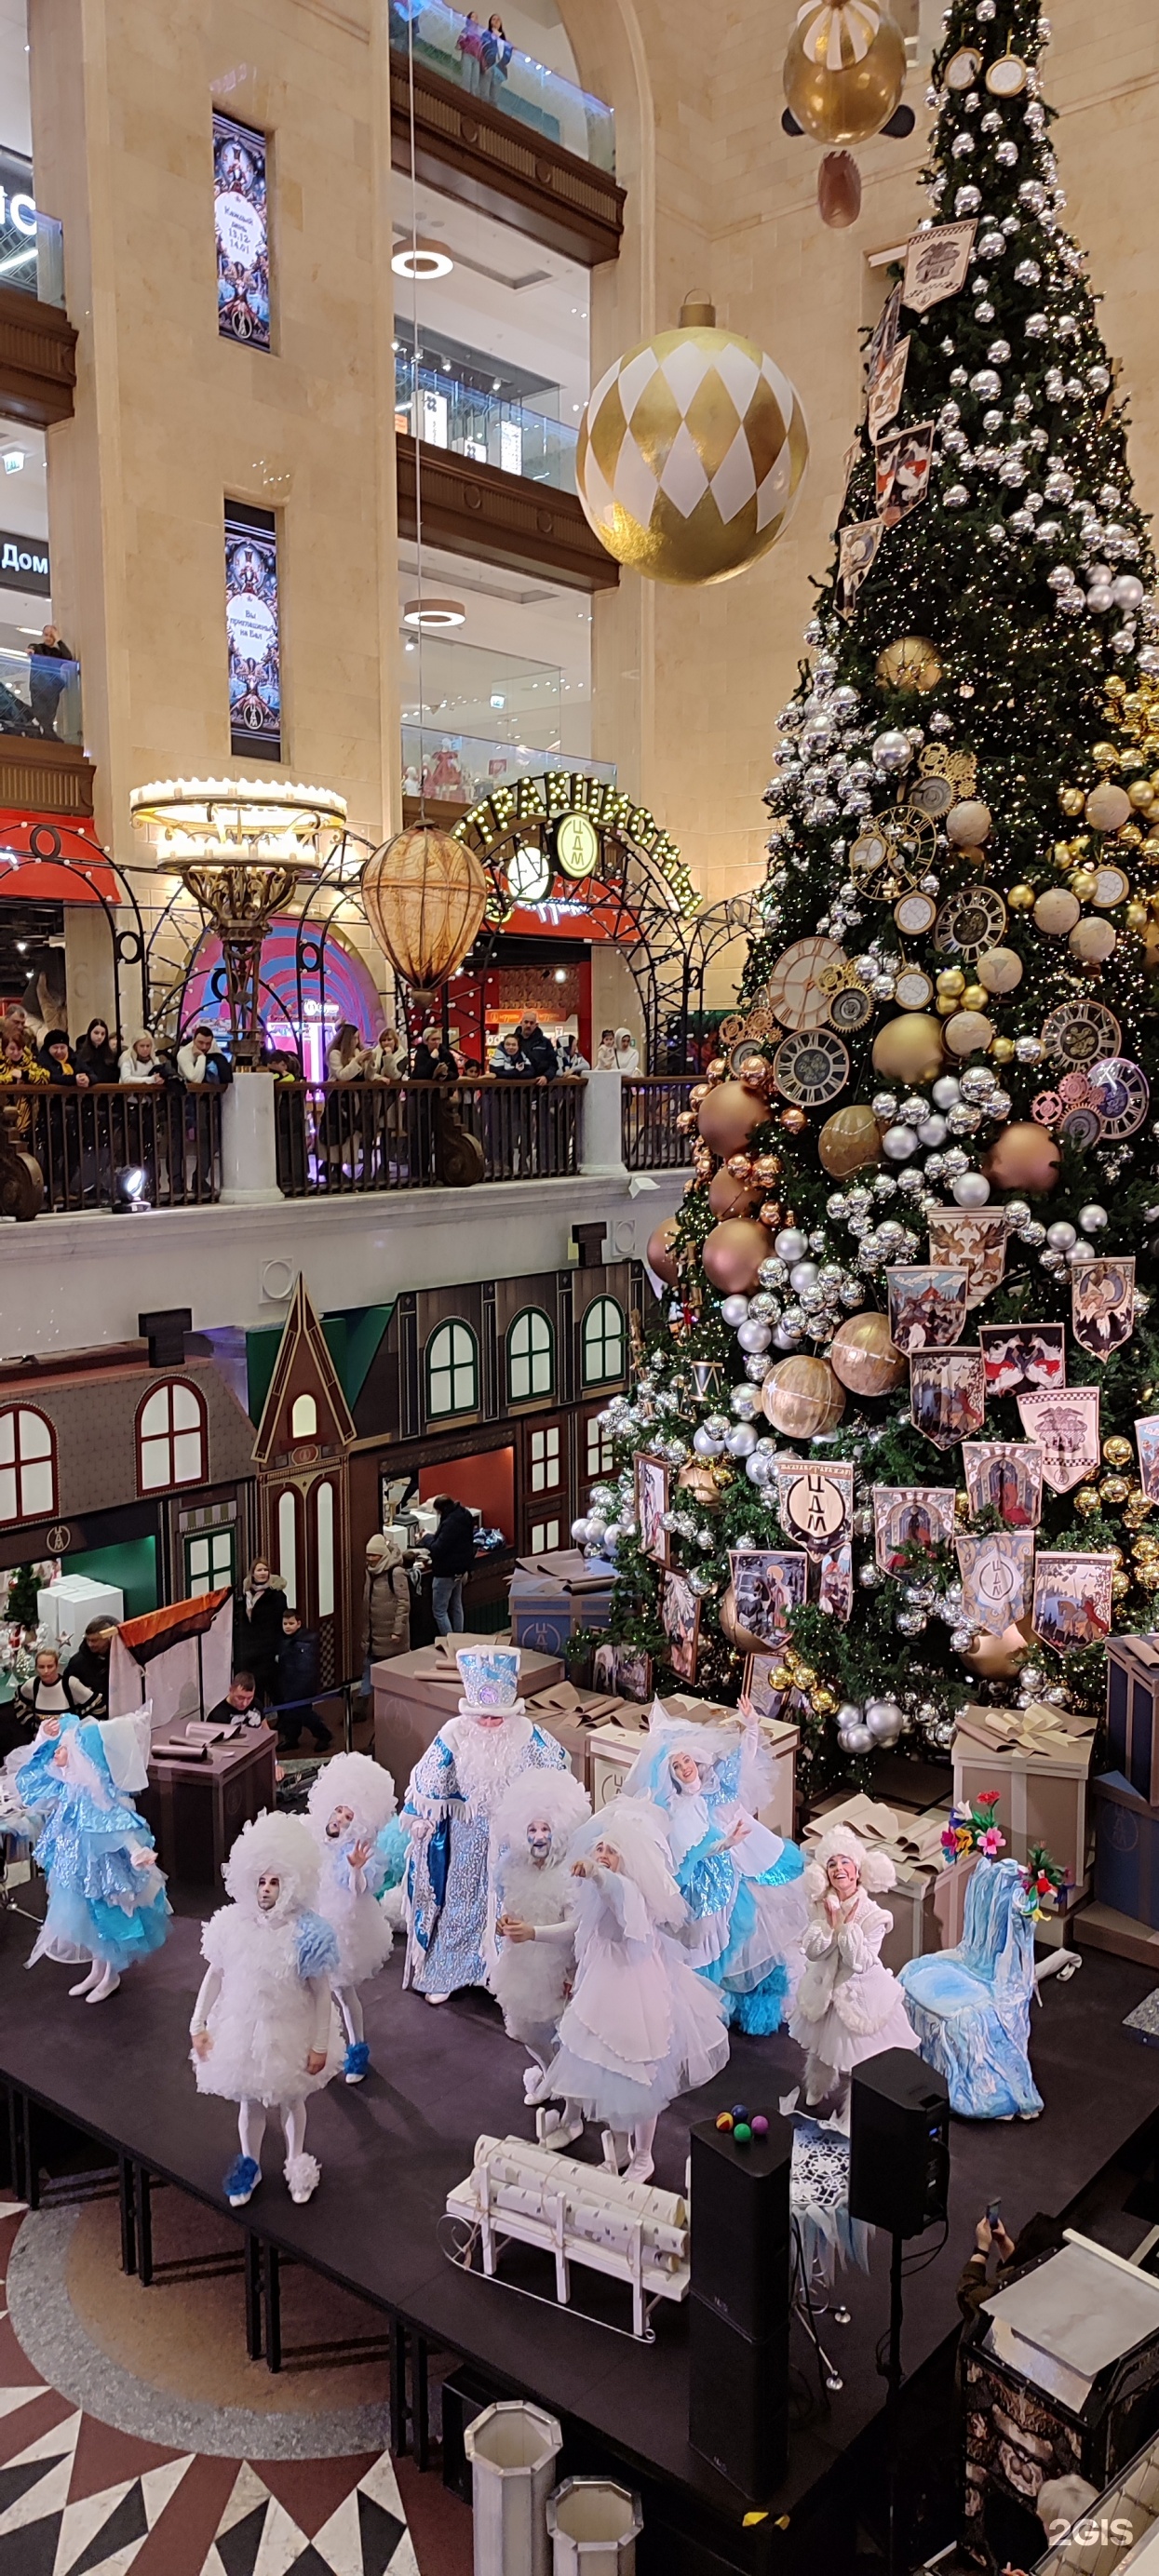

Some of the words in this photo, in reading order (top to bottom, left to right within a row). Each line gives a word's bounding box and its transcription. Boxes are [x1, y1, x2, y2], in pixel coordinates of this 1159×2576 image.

[1, 543, 48, 574] Дом
[245, 610, 256, 619] Вы
[451, 771, 704, 920] ТРАКЦИОНЫ
[571, 819, 585, 866] ЦДМ
[806, 1474, 827, 1533] ЦДМ
